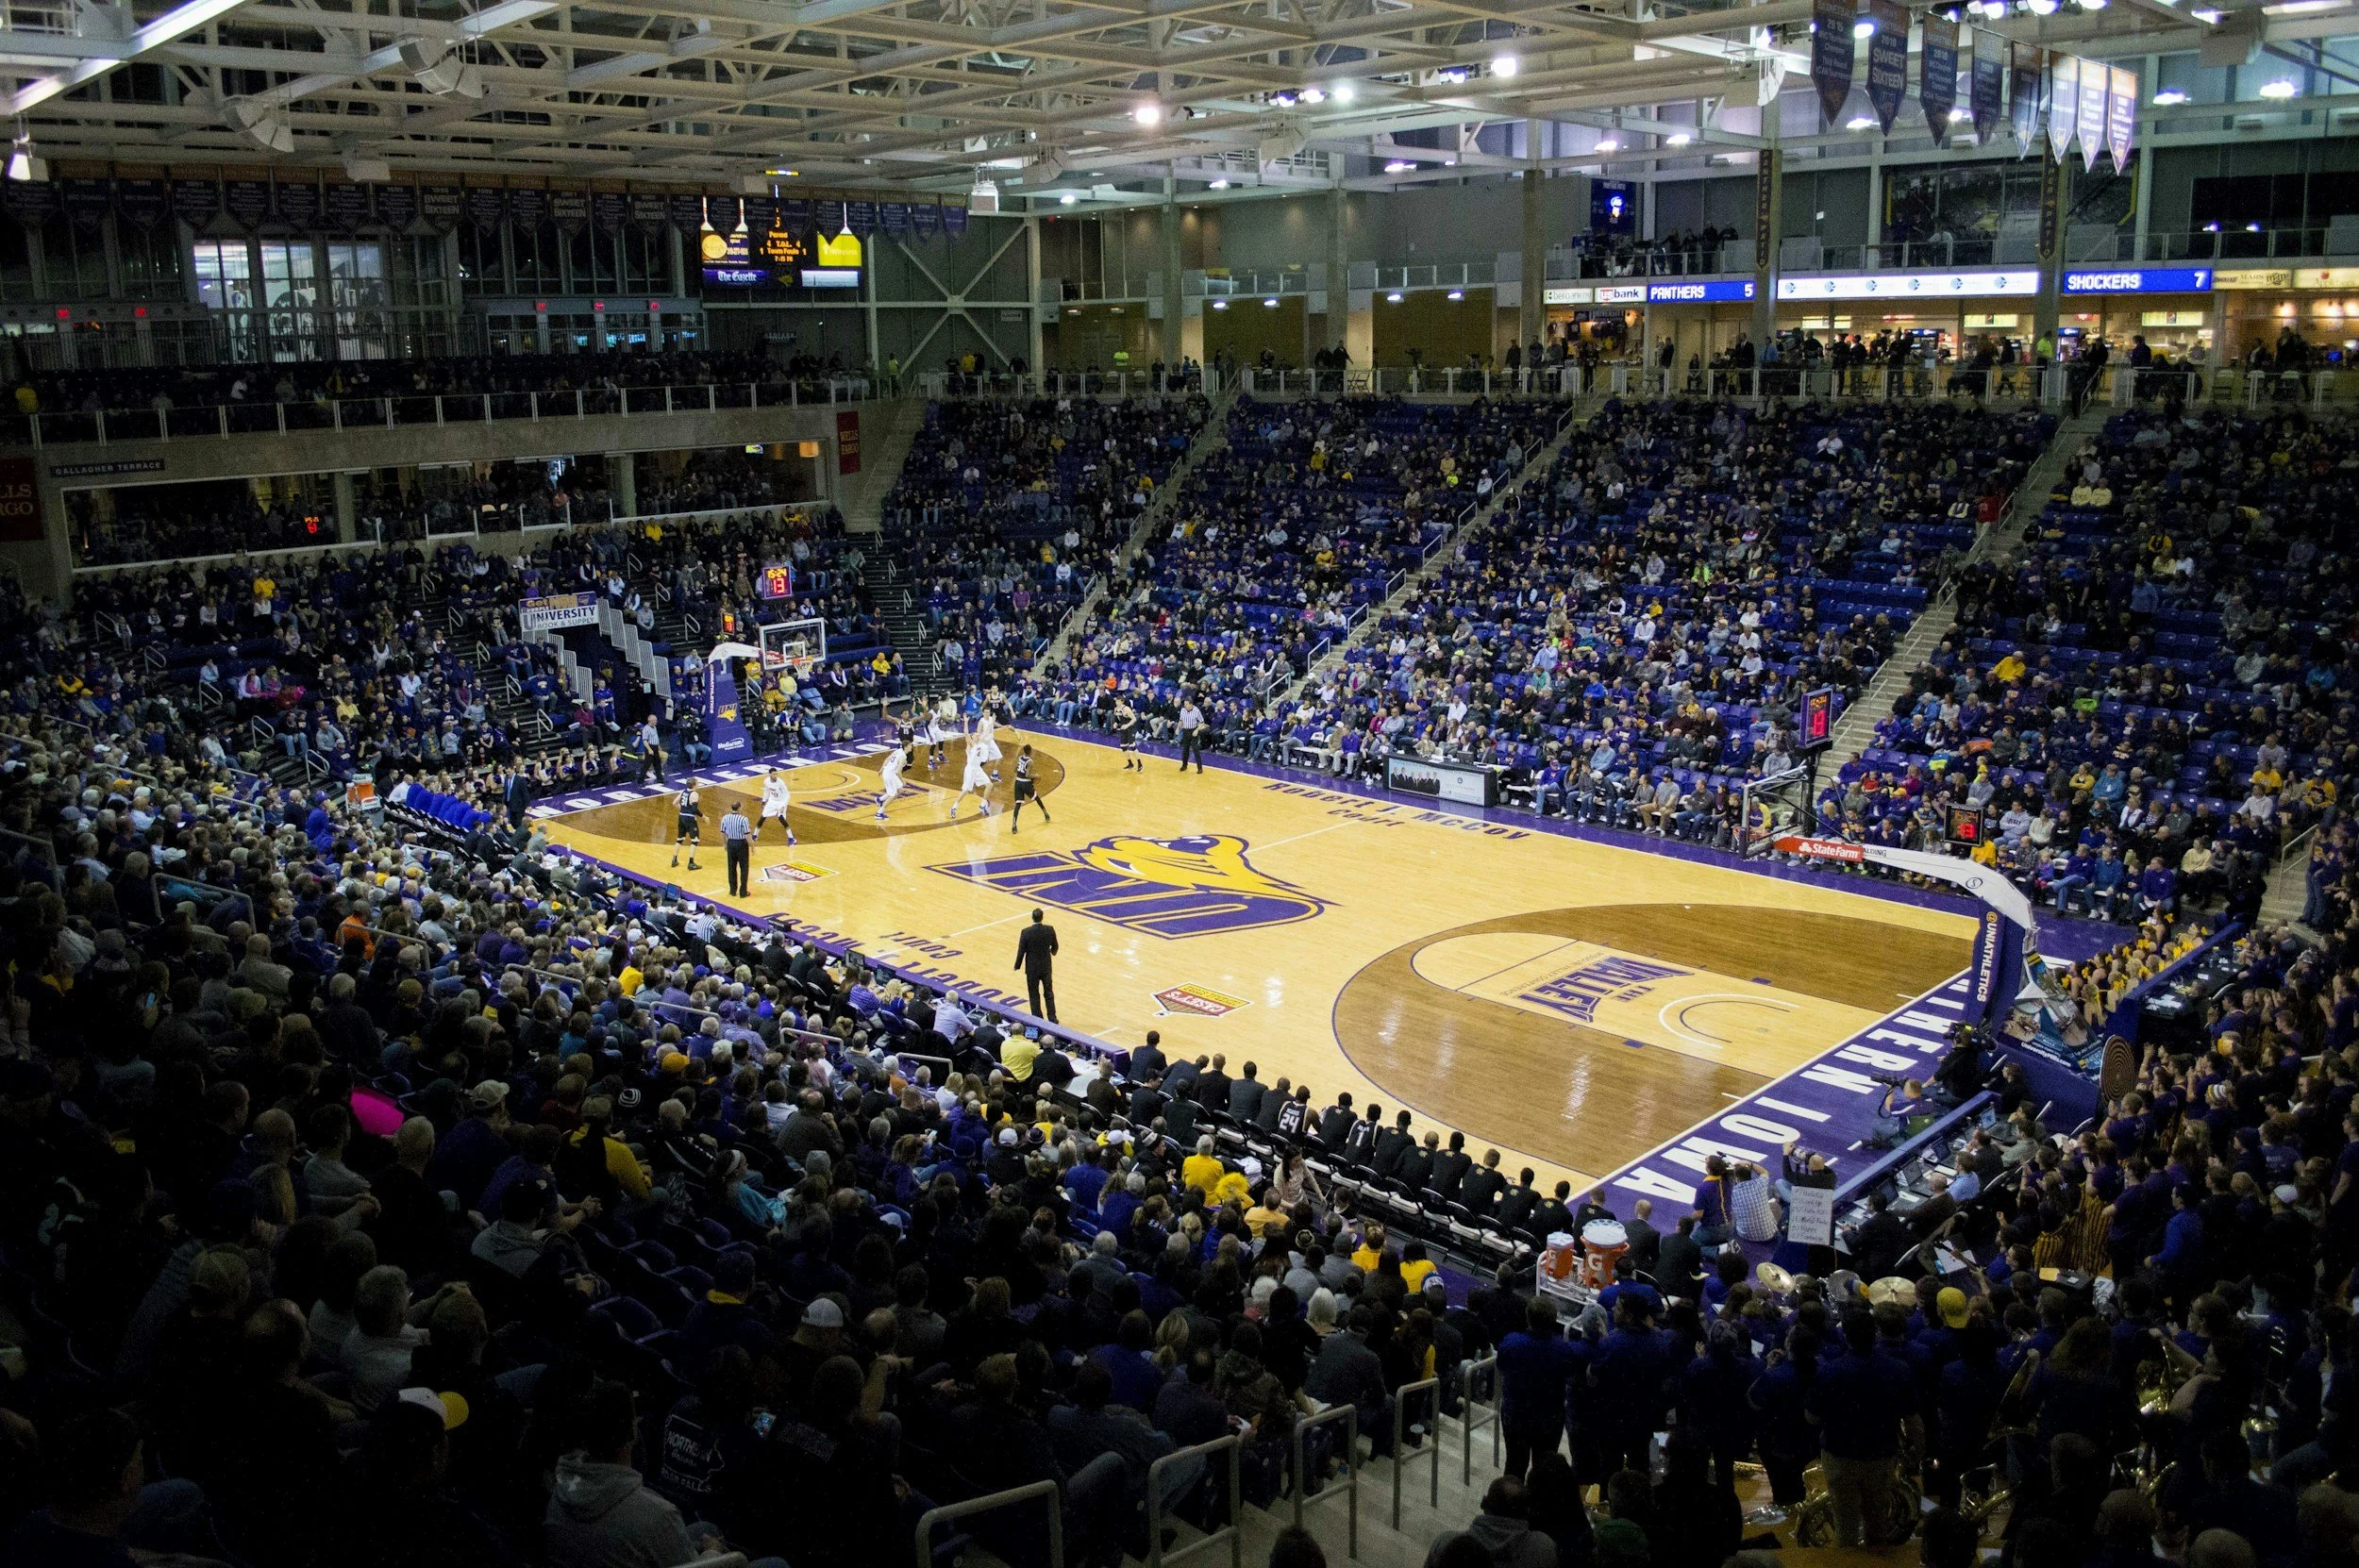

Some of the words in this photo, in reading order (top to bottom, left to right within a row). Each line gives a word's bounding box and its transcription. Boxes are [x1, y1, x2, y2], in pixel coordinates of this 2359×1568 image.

[1873, 48, 1905, 69] SWEET
[1872, 67, 1904, 90] SIXTEEN
[718, 271, 731, 281] The
[732, 271, 757, 281] Gazette
[2067, 275, 2141, 291] SHOCKERS
[2194, 273, 2205, 287] 7
[1651, 286, 1704, 300] PANTHERS
[1745, 284, 1753, 297] 5
[840, 430, 859, 442] WELLS
[55, 463, 114, 475] GALLAGHER
[119, 461, 161, 472] TERRACE
[767, 568, 787, 579] 15:24
[523, 607, 596, 630] UNIVERSITY
[568, 617, 594, 626] SUPPLY
[718, 703, 736, 715] UNI
[1263, 782, 1376, 809] Robert
[1413, 811, 1531, 841] McCoy
[1976, 911, 1998, 1002] @UNIATHLETICS
[1517, 956, 1696, 1024] VALLEY
[1612, 983, 1656, 1004] THE
[1164, 991, 1228, 1012] CASEY'S
[1279, 1113, 1301, 1134] 24
[1613, 1095, 1832, 1205] IOWA
[1548, 1249, 1556, 1259] G
[1588, 1253, 1603, 1271] G
